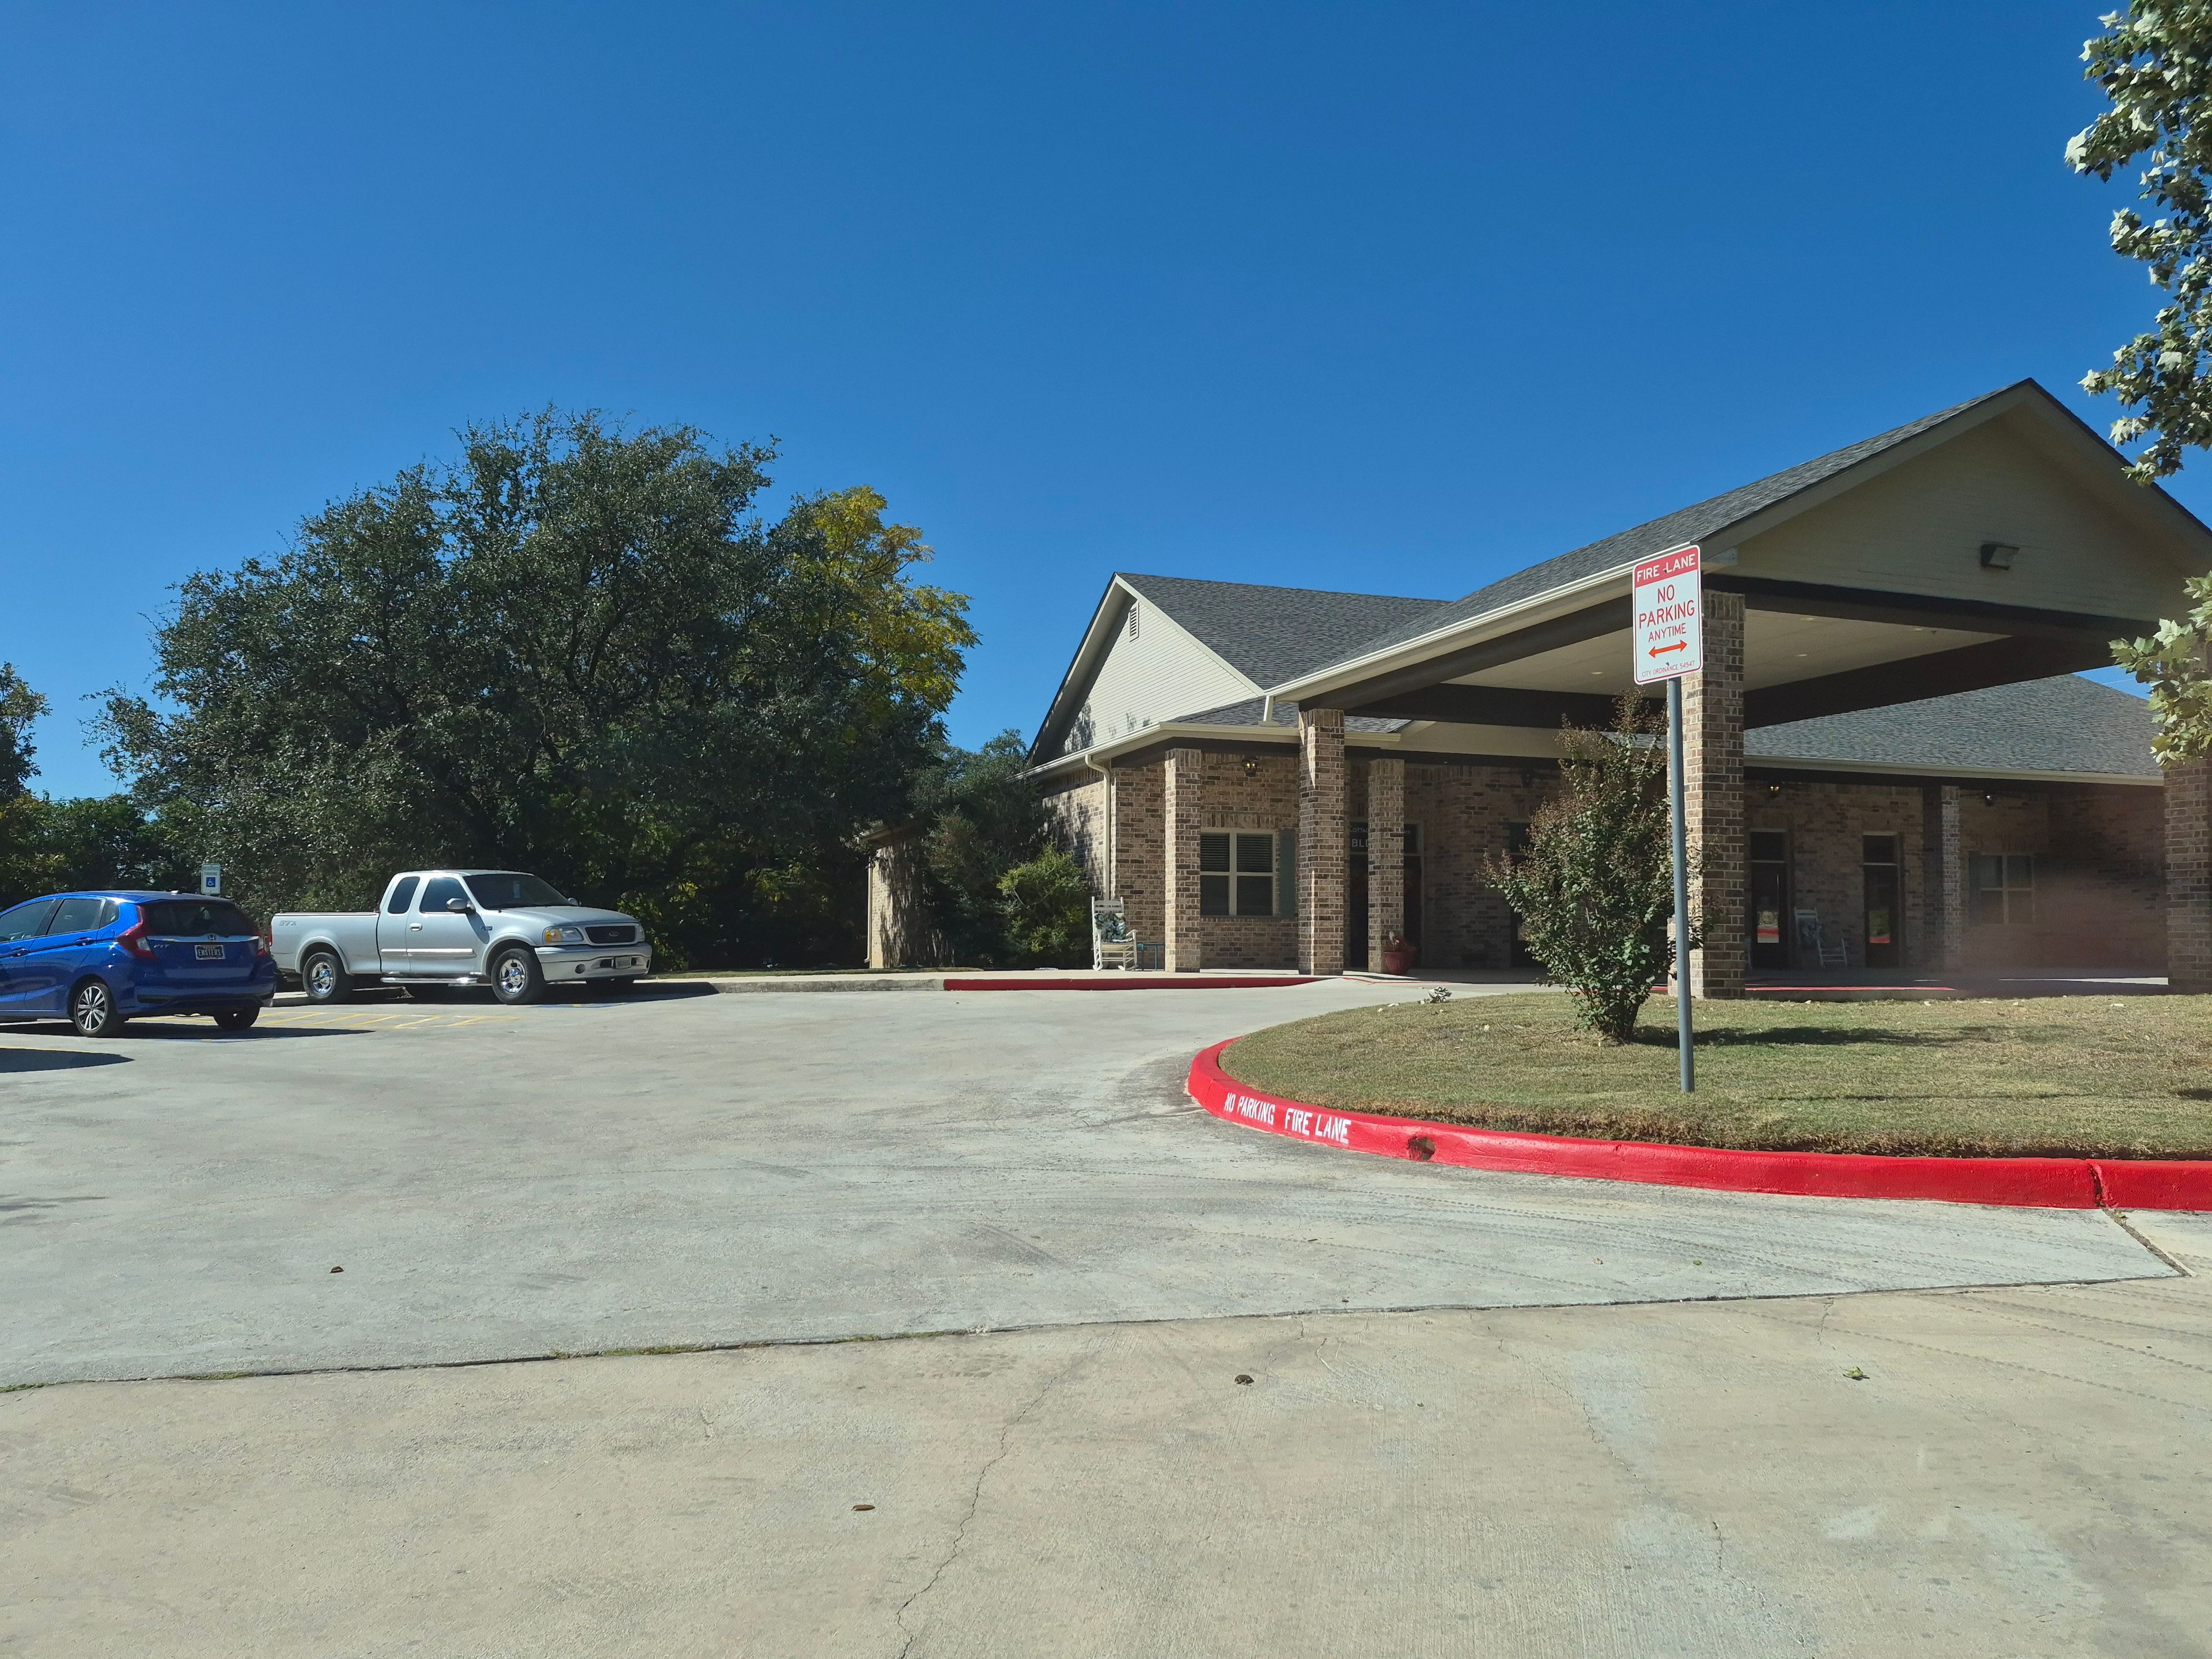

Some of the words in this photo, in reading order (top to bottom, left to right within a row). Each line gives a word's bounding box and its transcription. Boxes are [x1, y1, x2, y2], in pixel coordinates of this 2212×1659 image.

[1637, 565, 1660, 582] FIRE
[1666, 554, 1696, 574] LANE
[1657, 584, 1675, 604] NO
[1639, 600, 1695, 629] PARKING
[1648, 623, 1687, 642] ANYTIME
[1653, 664, 1678, 675] ORDINANCE
[1224, 1092, 1236, 1112] NO
[1237, 1096, 1276, 1125] PARKING
[1285, 1108, 1313, 1136] FIRE
[1315, 1114, 1351, 1145] LANE
